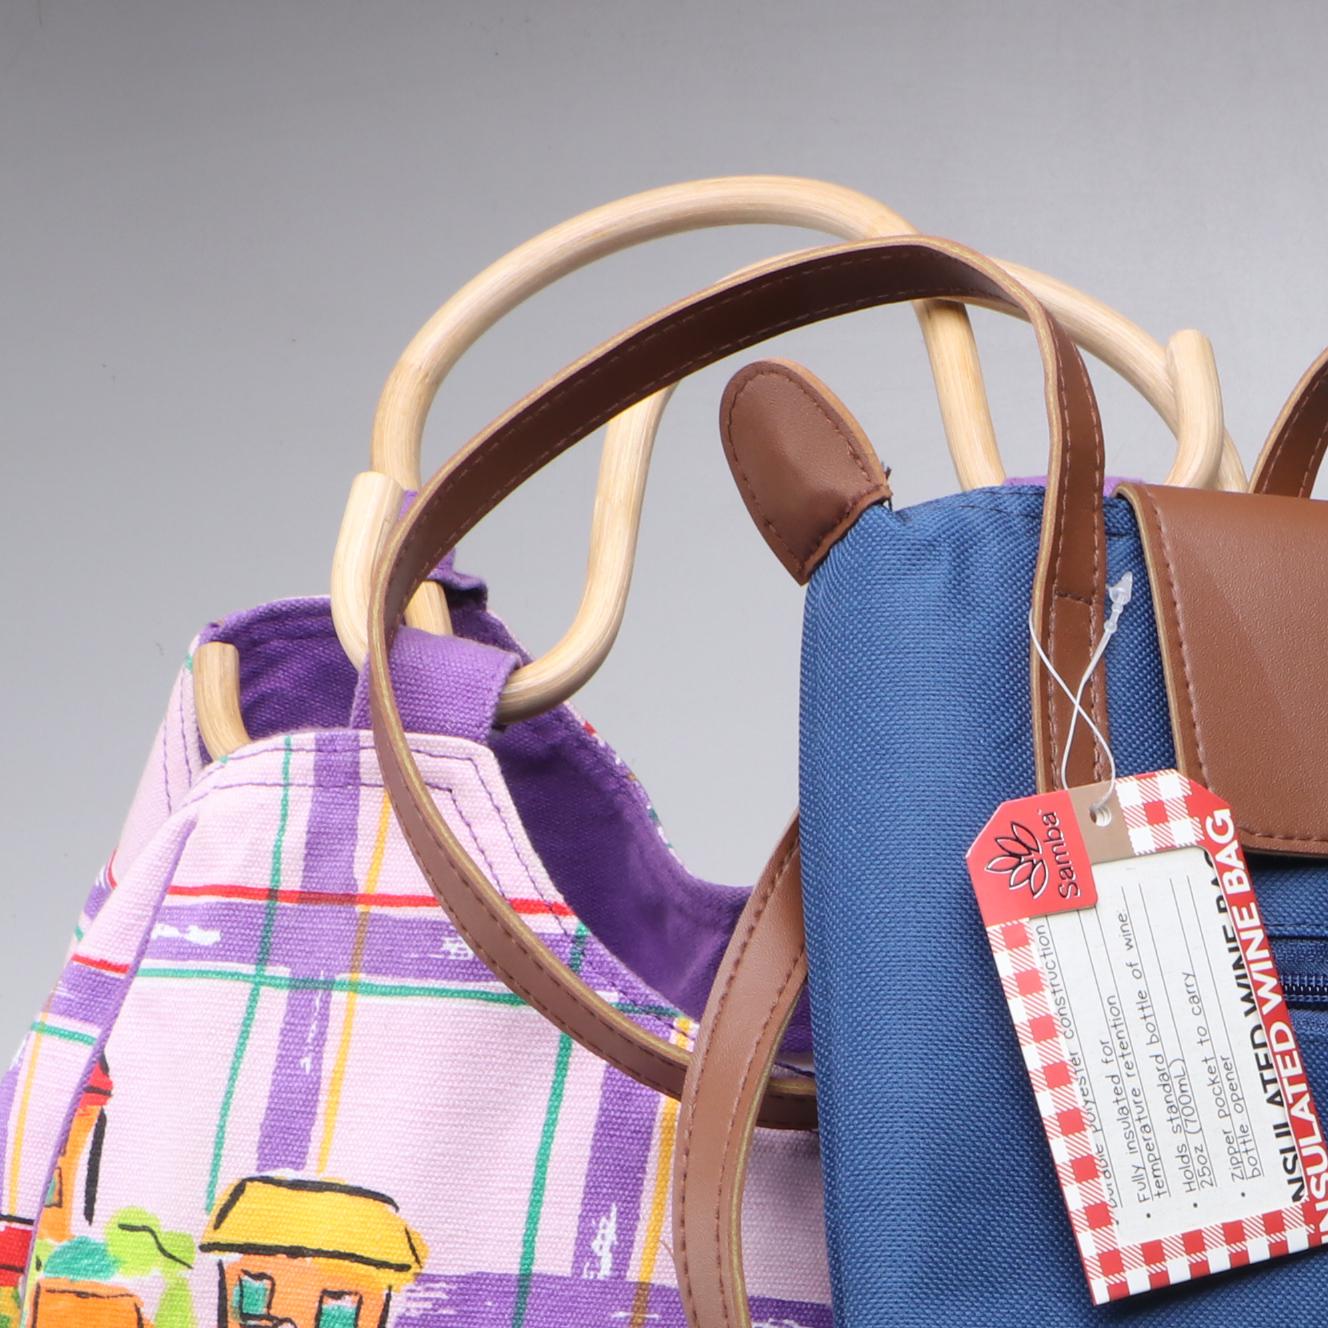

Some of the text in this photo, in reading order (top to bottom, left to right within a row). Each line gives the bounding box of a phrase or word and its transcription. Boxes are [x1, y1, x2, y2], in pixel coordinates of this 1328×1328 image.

[1041, 811, 1080, 899] Samba
[1205, 808, 1250, 894] BAG
[1035, 924, 1075, 1040] construction
[1125, 961, 1143, 980] of
[1231, 901, 1284, 1015] WINE
[1135, 990, 1160, 1046] bottle
[1182, 968, 1245, 1182] Zipper pocket to carry
[1099, 1040, 1154, 1204] Fully insulated for
[1106, 995, 1171, 1199] temperature retention
[1149, 1054, 1183, 1134] standard
[1165, 1056, 1214, 1189] 25oz (700mL)
[1220, 1055, 1262, 1180] bottle opener
[1249, 1024, 1310, 1203] NSULATED
[1095, 1143, 1118, 1209] Durable
[1175, 1143, 1197, 1193] Holds
